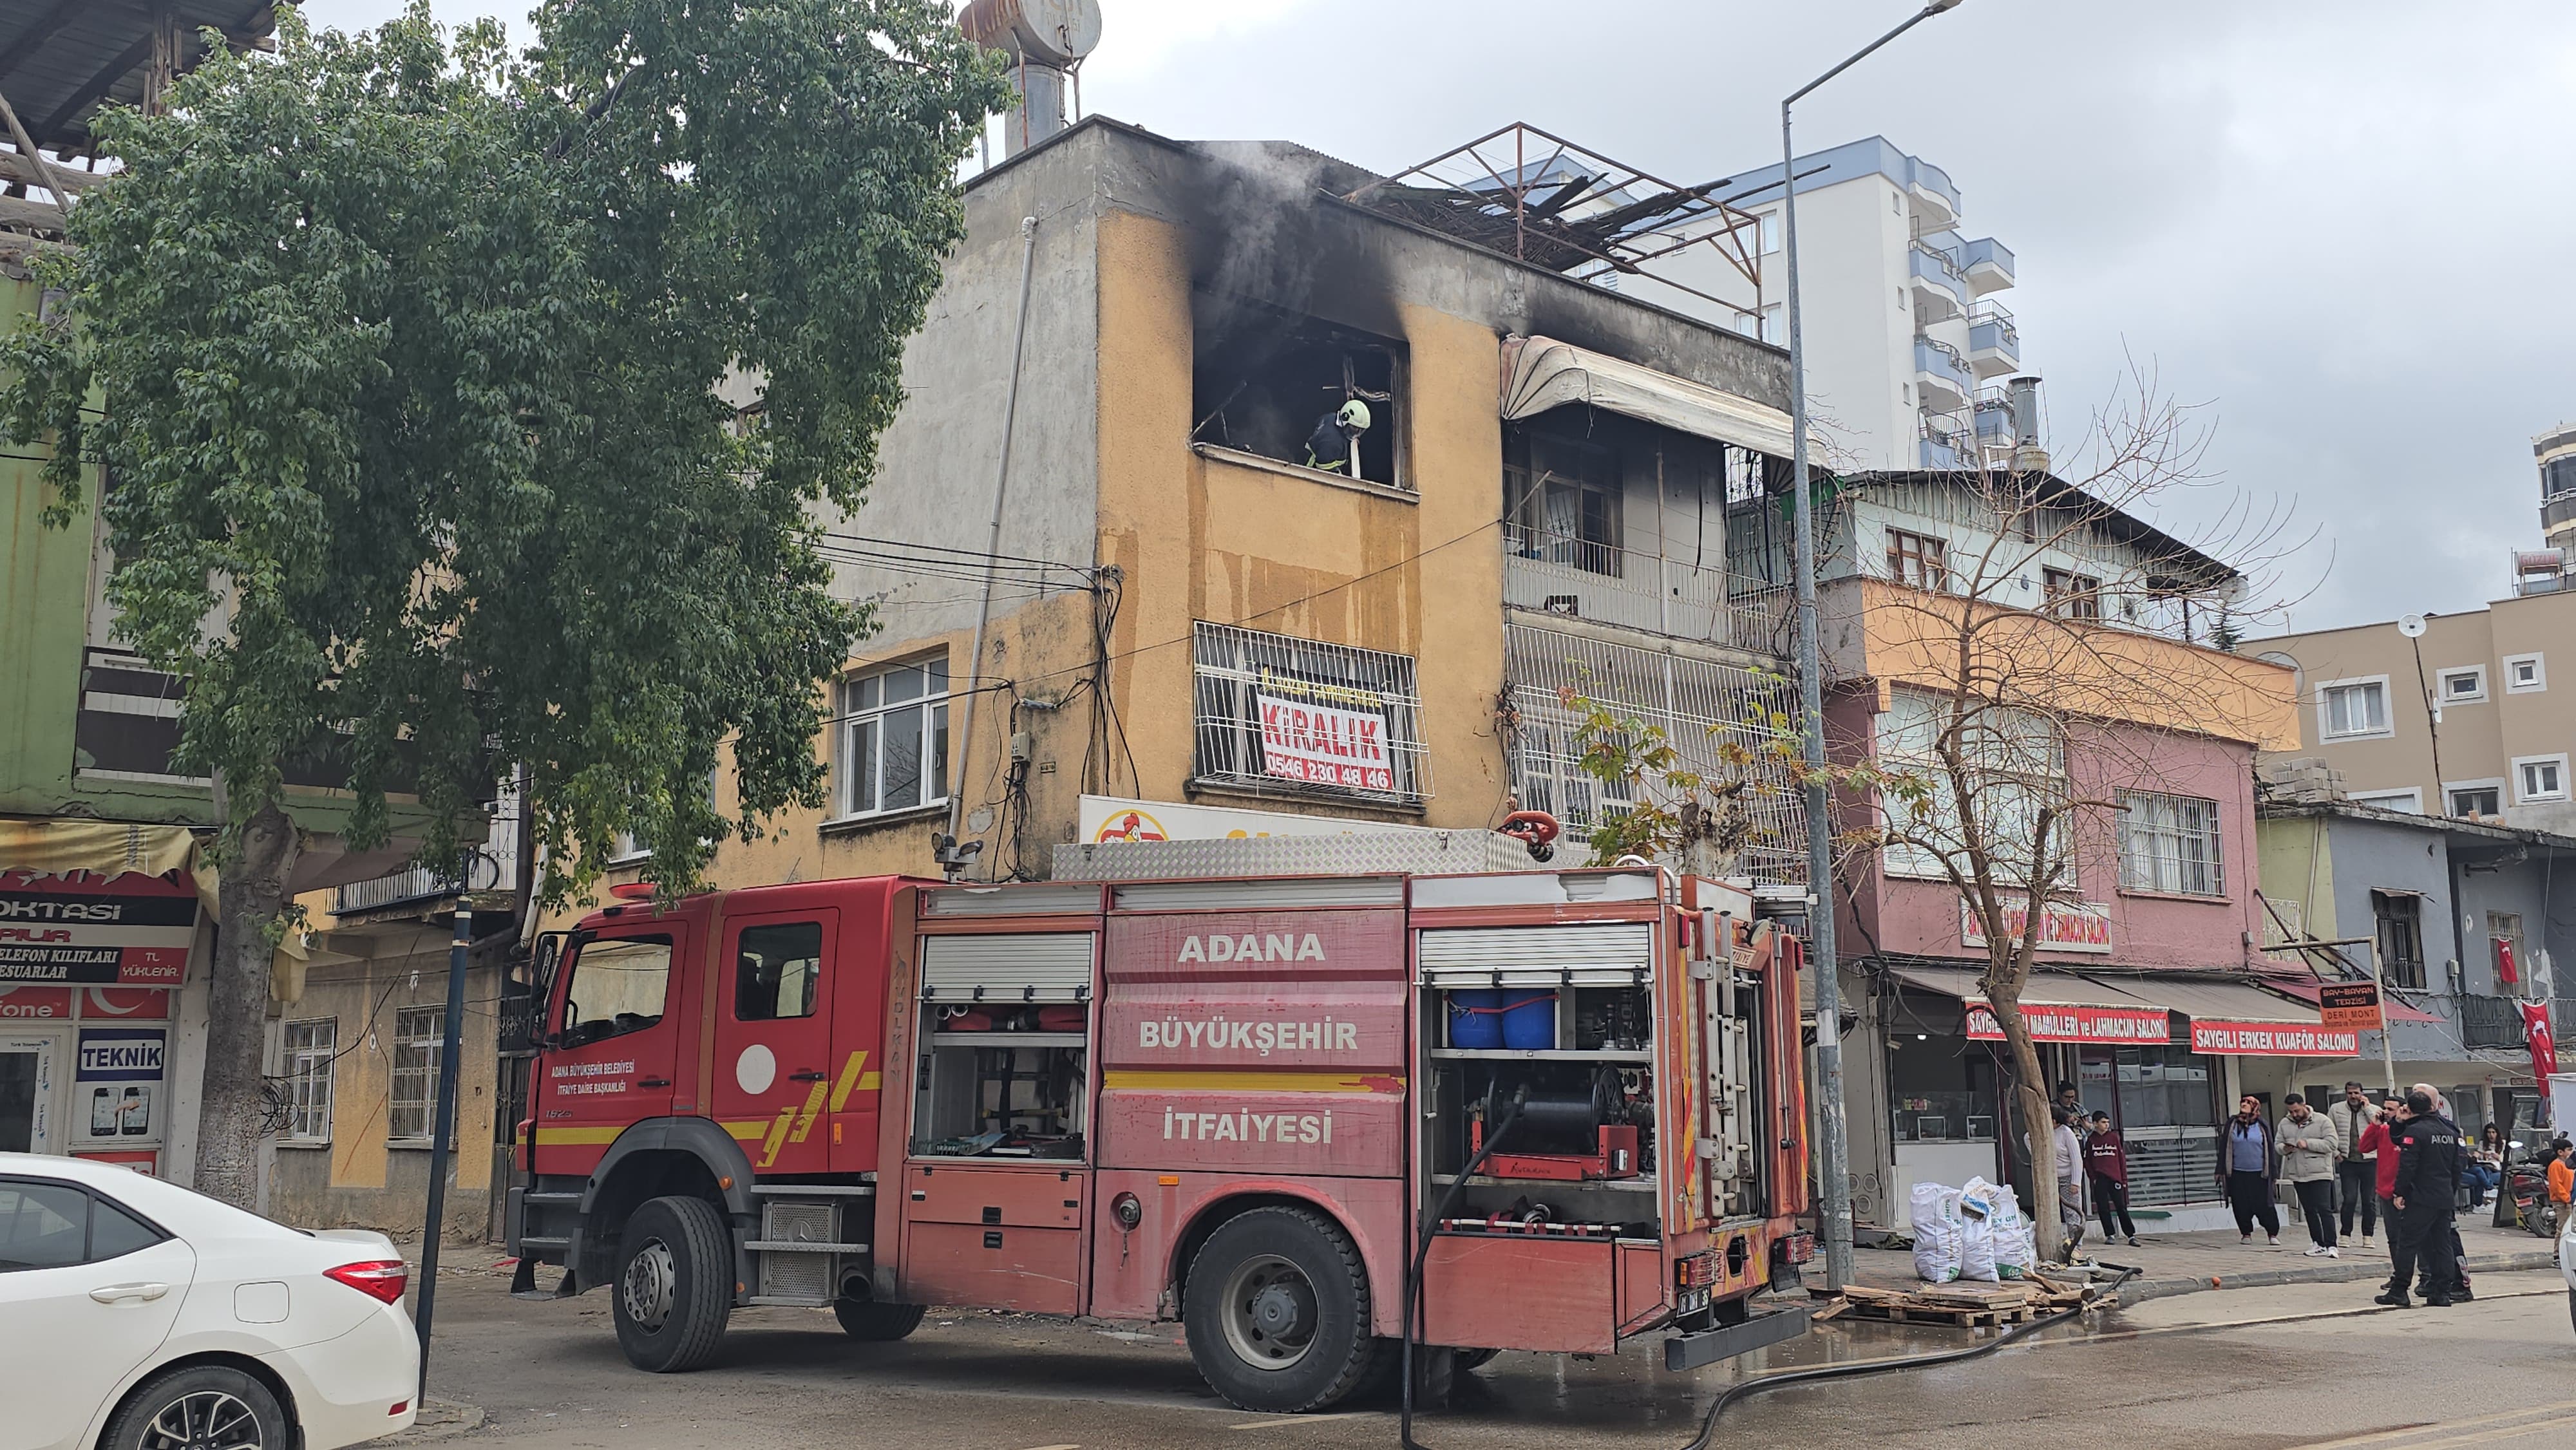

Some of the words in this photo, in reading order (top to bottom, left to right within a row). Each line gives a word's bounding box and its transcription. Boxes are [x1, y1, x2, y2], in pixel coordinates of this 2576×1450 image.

[1266, 754, 1303, 778] 0546
[1307, 760, 1335, 782] 230
[1342, 768, 1361, 786] 48
[1367, 770, 1388, 788] 46
[50, 950, 118, 963] KILIFLARI
[146, 952, 160, 962] TL
[1177, 933, 1326, 963] ADANA
[2323, 986, 2374, 997] BAY-BAYAN
[1969, 1012, 2003, 1033] SAYGIL
[2351, 1009, 2375, 1018] MONT
[1140, 1015, 1358, 1056] BÜYÜKŞEHİR
[2080, 1021, 2090, 1036] ve
[2092, 1017, 2134, 1037] LAHMACUN
[2136, 1019, 2167, 1038] SALONU
[2196, 1029, 2237, 1049] SAYGILI
[2240, 1030, 2274, 1050] ERKEK
[2275, 1028, 2315, 1050] KUAFÖR
[2317, 1033, 2355, 1051] SALONU
[83, 1042, 161, 1067] TEKNİK
[551, 1066, 569, 1078] ADANA
[604, 1058, 634, 1075] BELEDİYESİ
[558, 1083, 577, 1095] İTFAİYE
[1164, 1106, 1332, 1144] İTFAİYESİ
